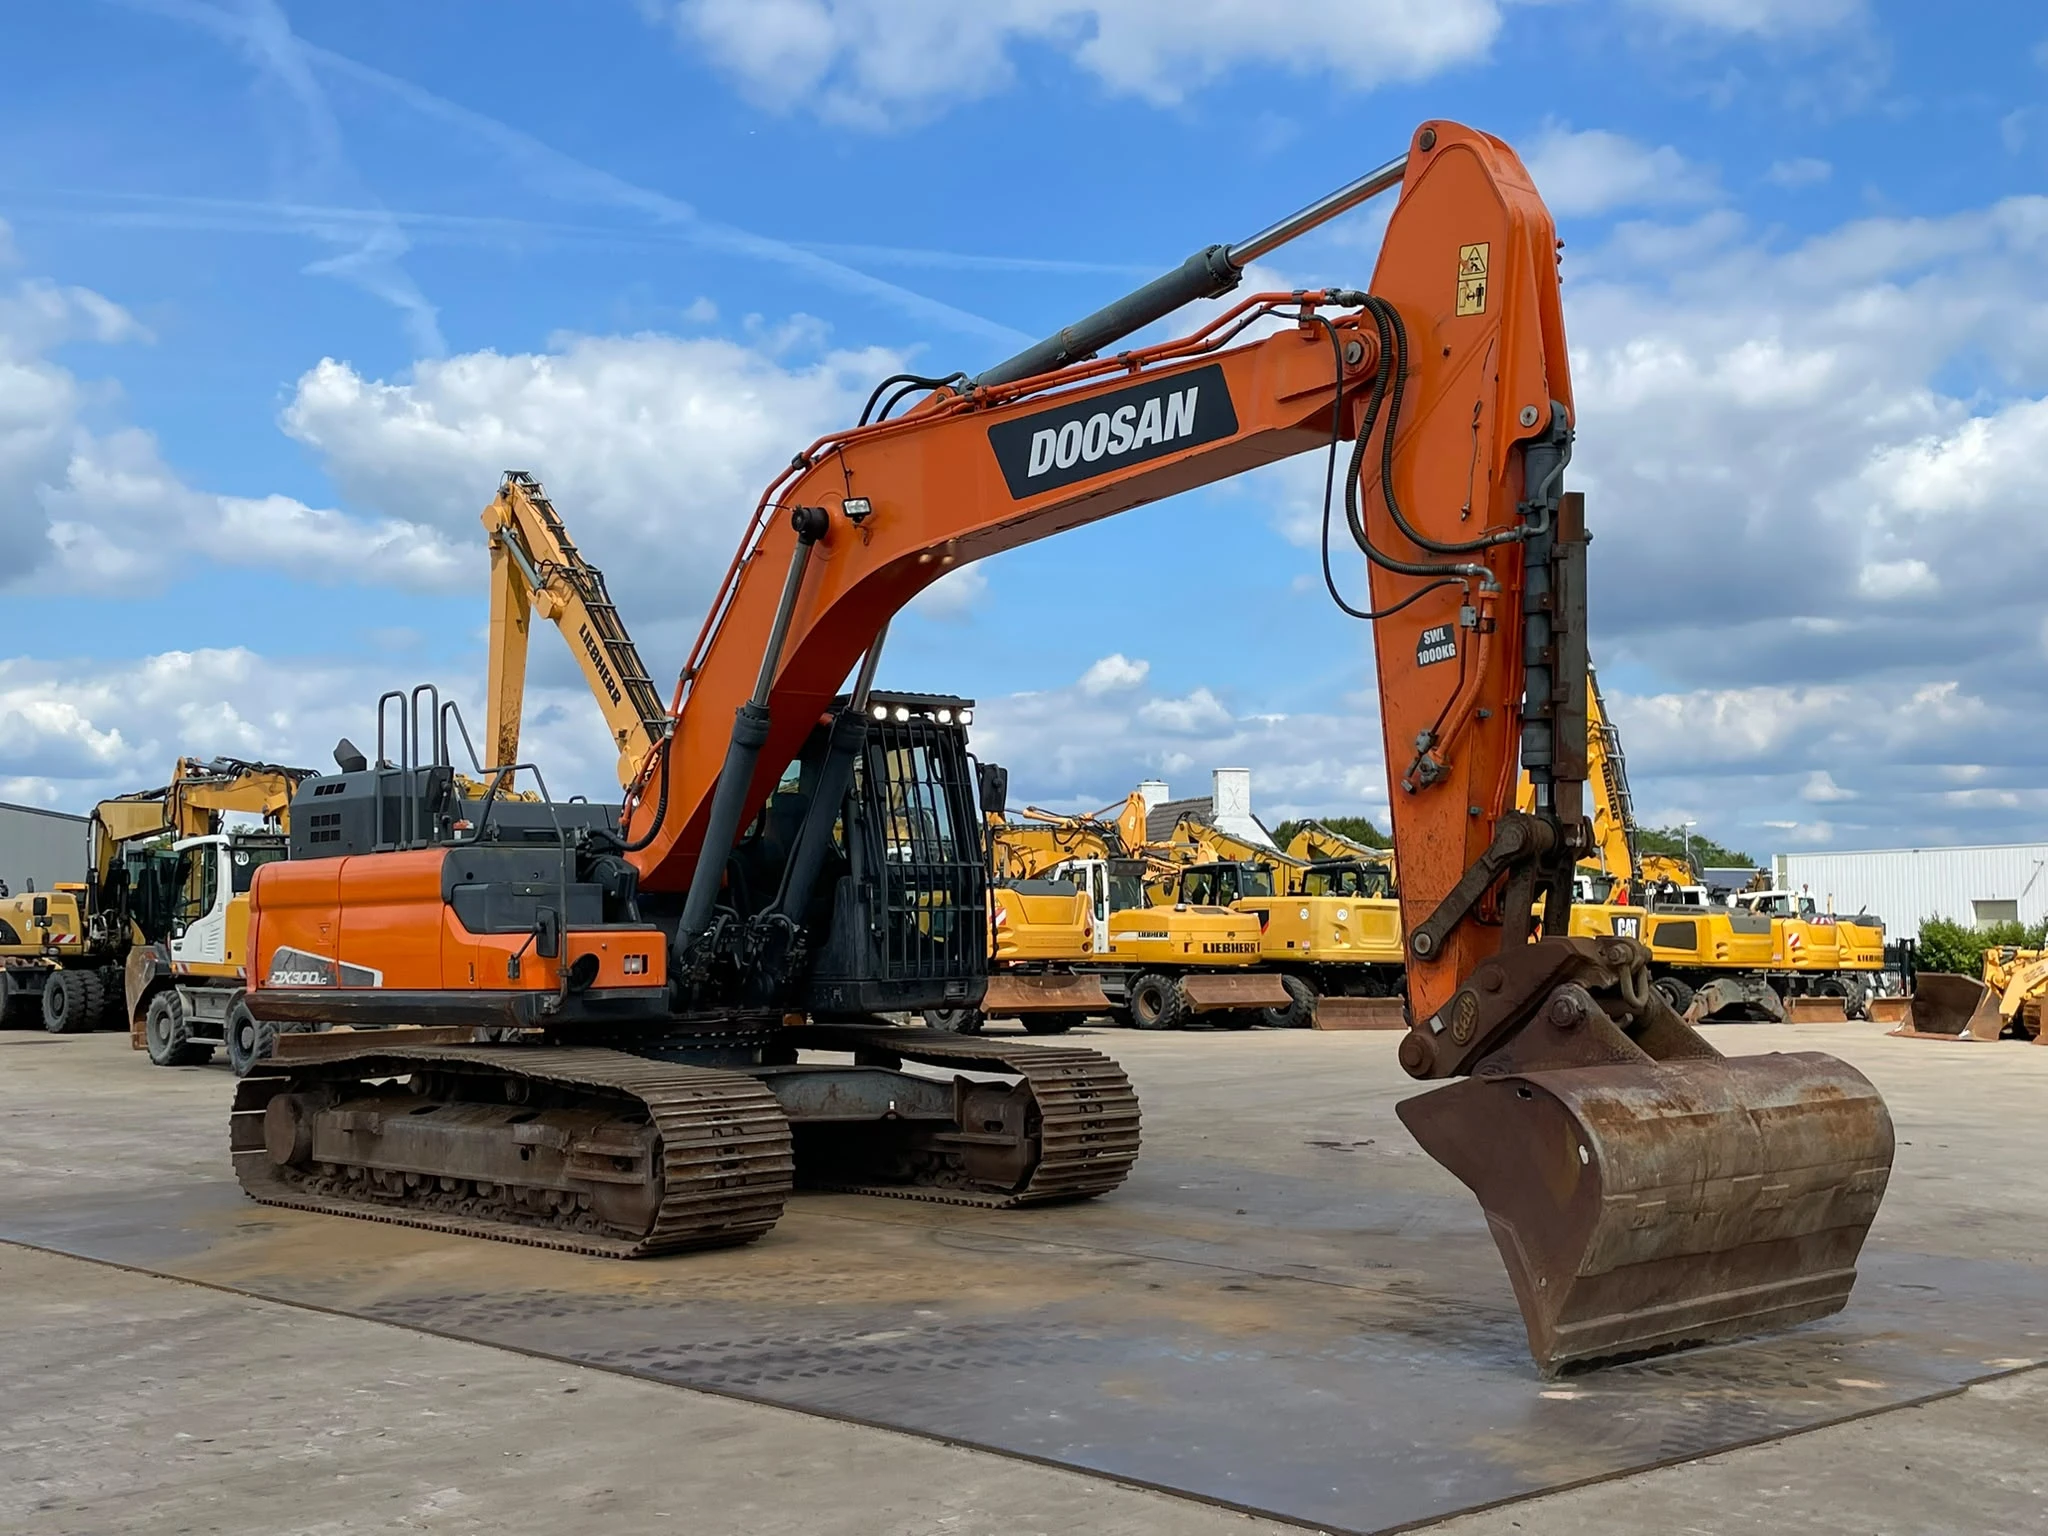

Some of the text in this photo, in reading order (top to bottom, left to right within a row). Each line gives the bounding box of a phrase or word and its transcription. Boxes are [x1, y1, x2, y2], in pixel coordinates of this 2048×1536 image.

[1027, 386, 1199, 478] DOOSAN
[1423, 627, 1446, 645] SWL
[579, 622, 621, 708] LIEBHERR
[1417, 642, 1456, 665] 1000KG
[1601, 762, 1620, 822] LIEBHERR
[1617, 917, 1637, 939] CAT
[1202, 942, 1255, 954] LIEBHERR
